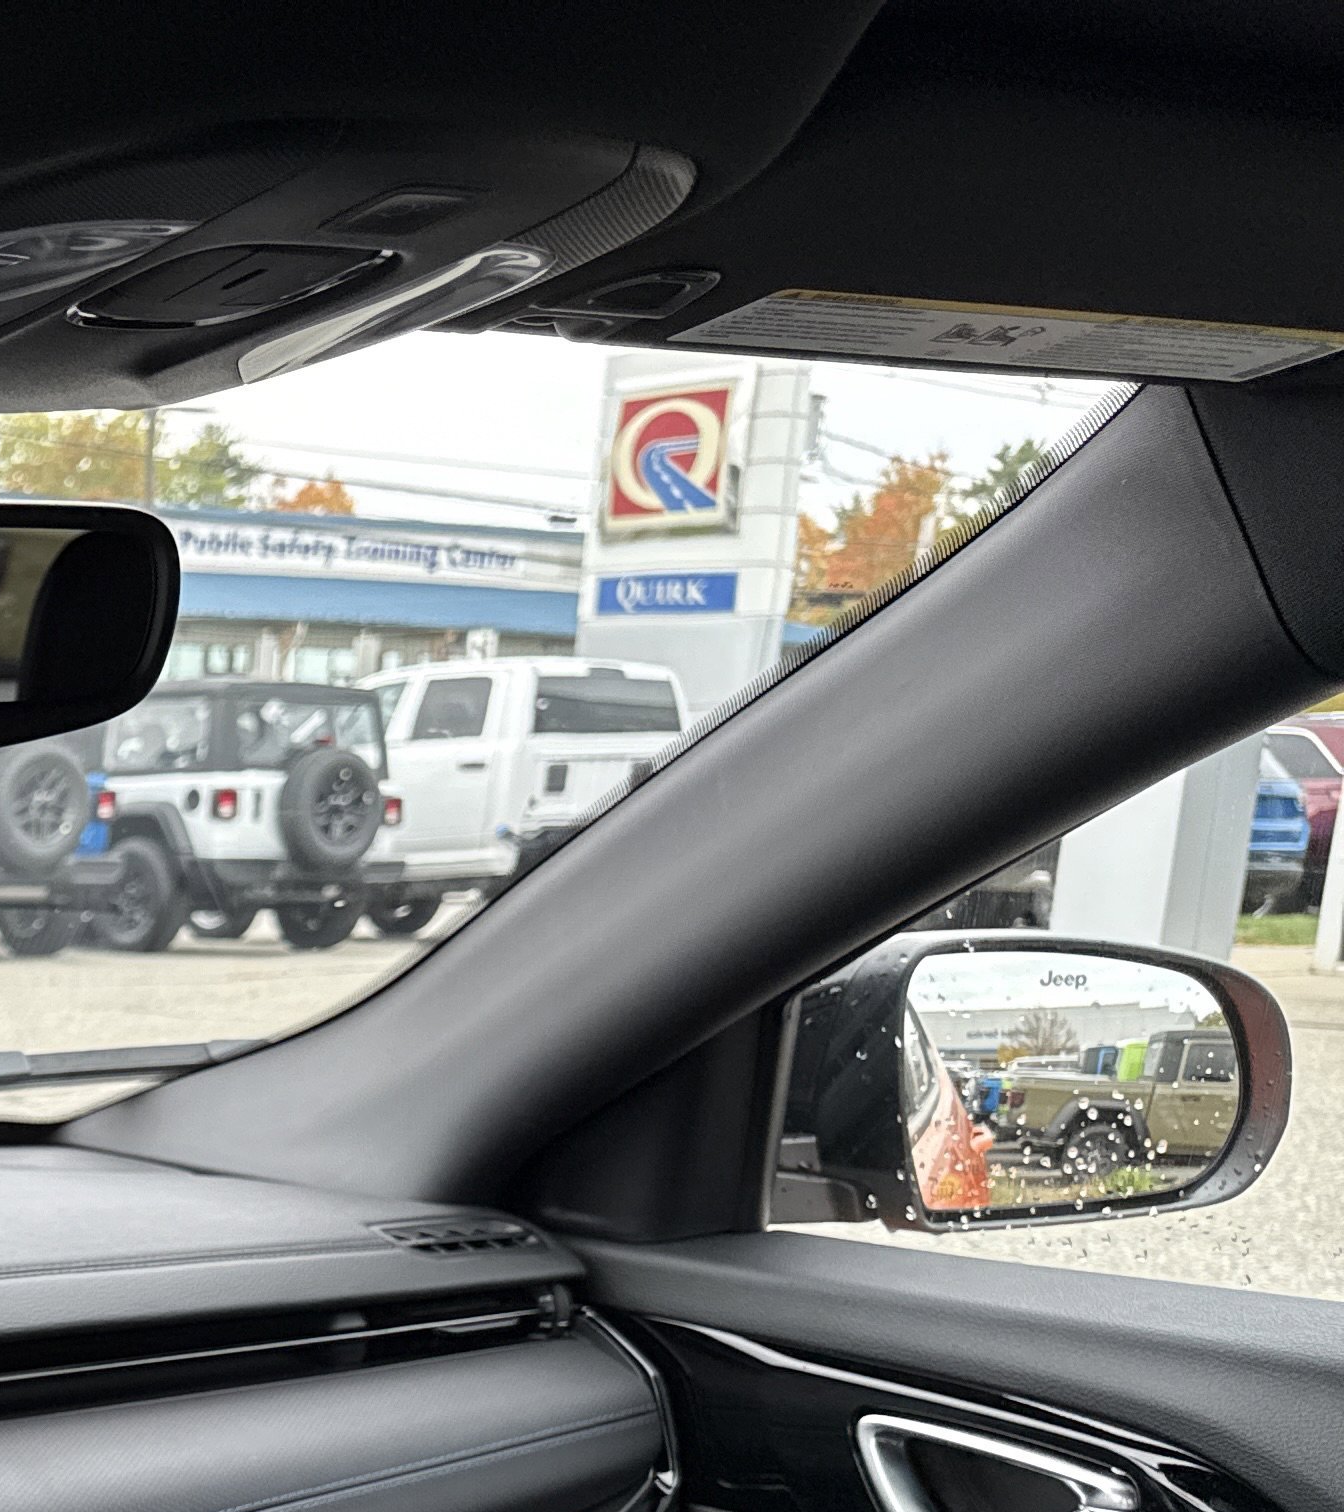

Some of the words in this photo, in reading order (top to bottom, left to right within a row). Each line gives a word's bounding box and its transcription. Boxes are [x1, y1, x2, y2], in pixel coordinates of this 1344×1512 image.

[179, 531, 250, 559] Public
[258, 532, 336, 567] Safety
[341, 536, 439, 574] Training
[446, 544, 518, 569] Center
[615, 576, 708, 613] QUIRK
[1039, 970, 1087, 990] Jeep
